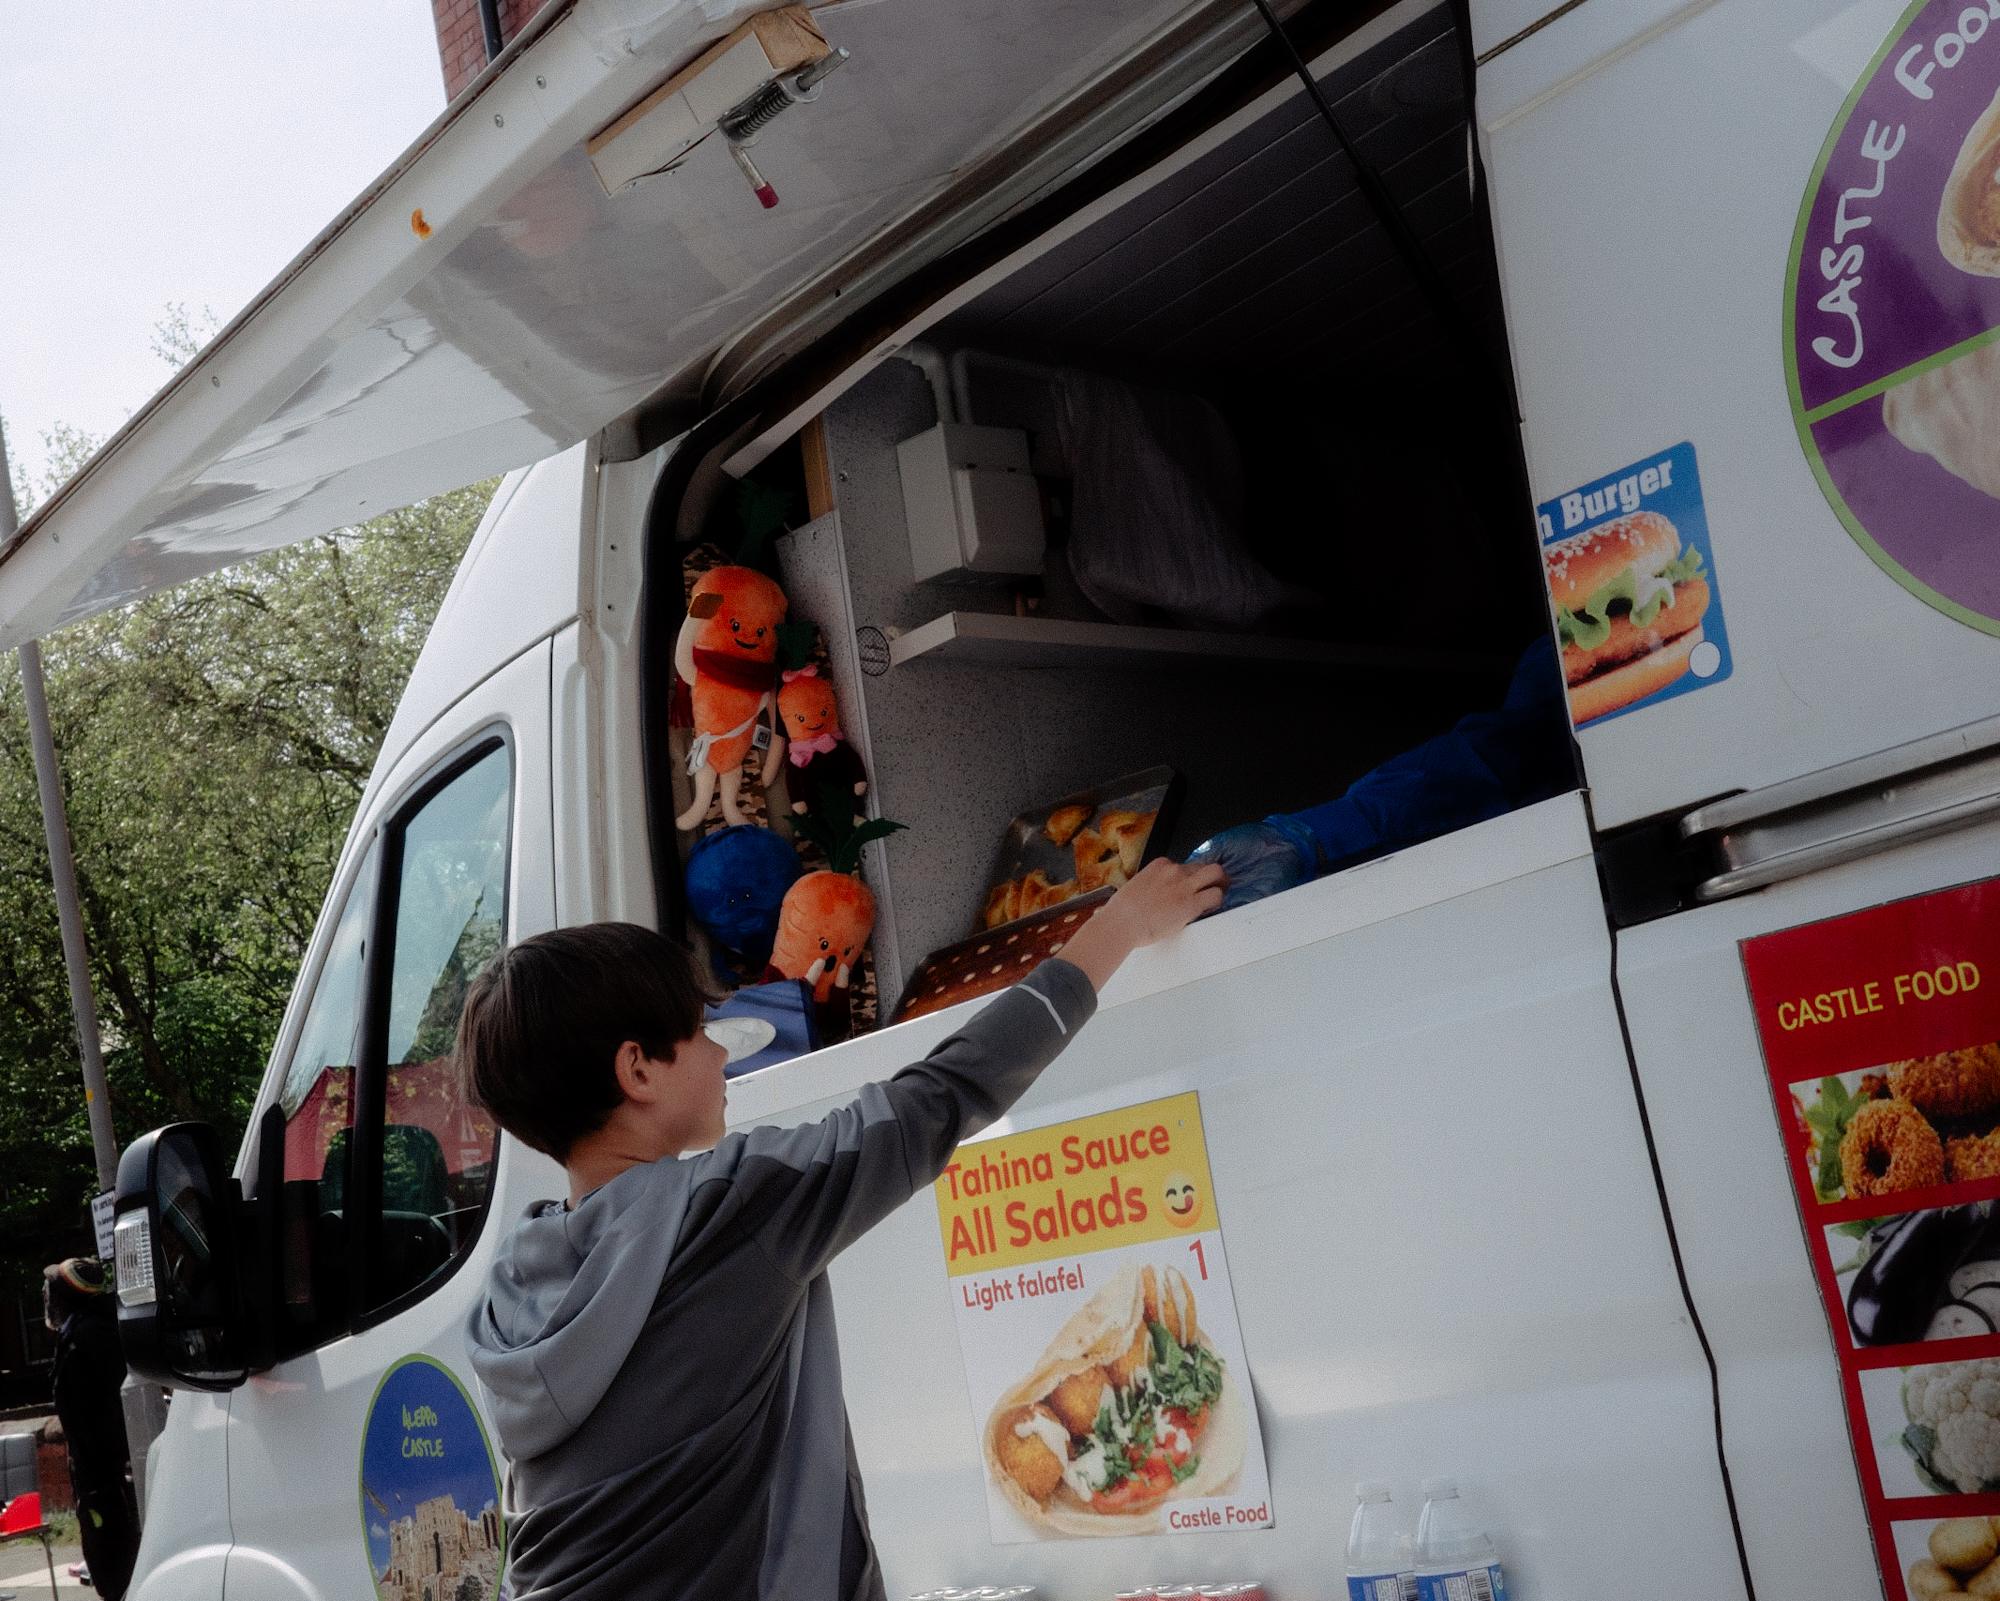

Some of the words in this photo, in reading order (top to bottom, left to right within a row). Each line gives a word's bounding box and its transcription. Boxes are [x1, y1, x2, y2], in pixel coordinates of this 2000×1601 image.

[1812, 120, 1906, 369] CASTLE
[1894, 0, 2000, 99] FOO
[1560, 459, 1672, 530] Burger
[1777, 981, 1883, 1031] CASTLE
[1894, 961, 1980, 1005] FOOD
[943, 1150, 1053, 1201] Tahina
[1061, 1125, 1170, 1175] Sauce
[949, 1205, 997, 1261] All
[1005, 1176, 1148, 1247] Salads
[962, 1278, 1014, 1310] Light
[1017, 1263, 1084, 1298] falafel
[1189, 1238, 1208, 1281] 1
[402, 1436, 445, 1458] CASTLE
[1169, 1506, 1221, 1529] Castle
[1225, 1501, 1268, 1524] Food
